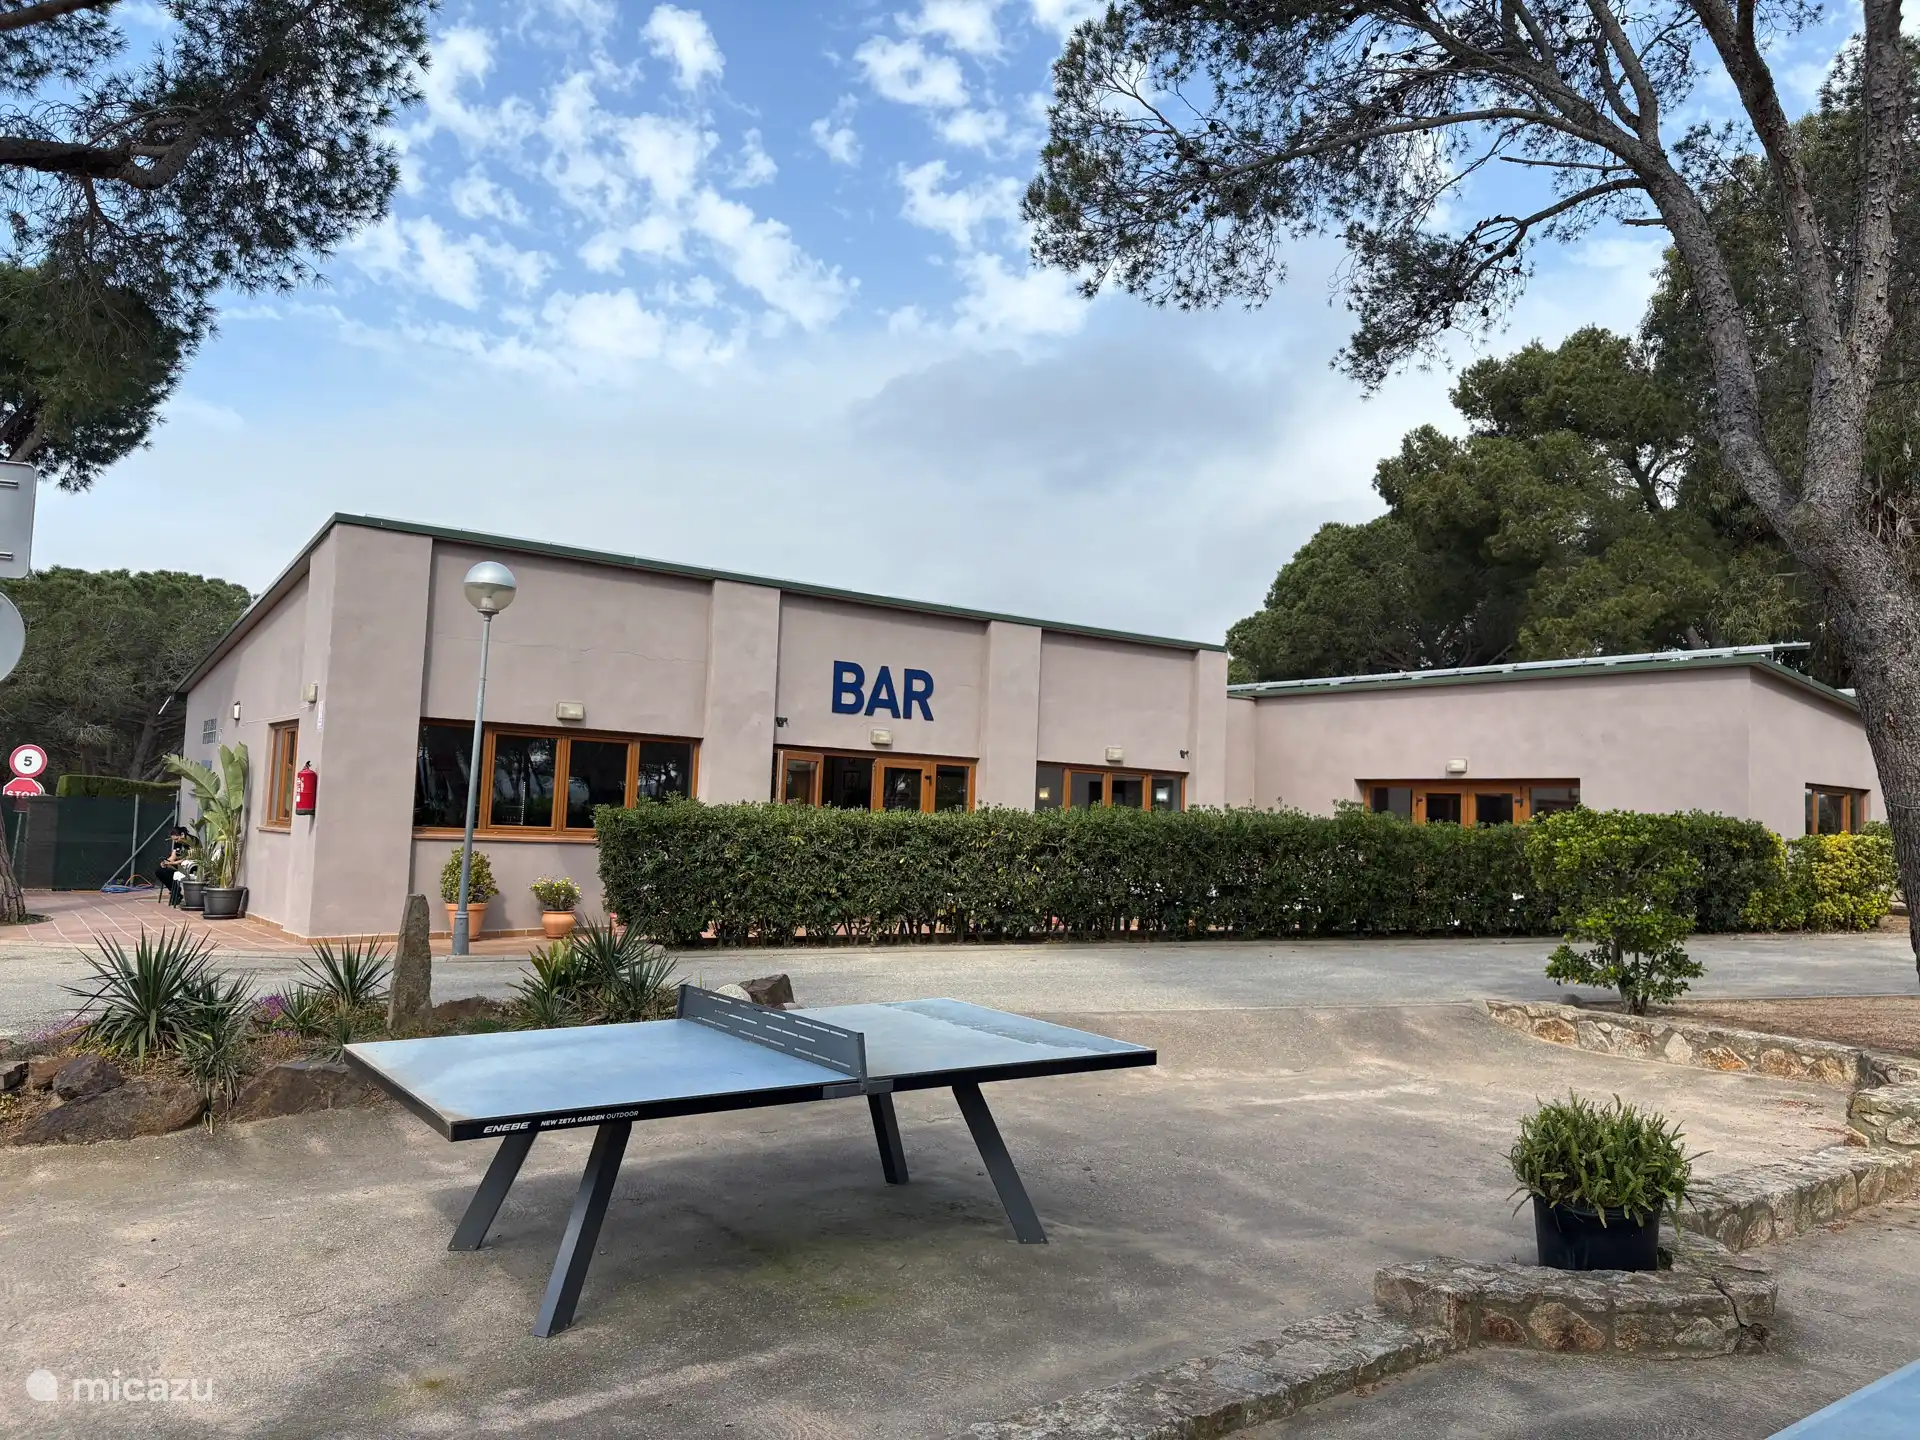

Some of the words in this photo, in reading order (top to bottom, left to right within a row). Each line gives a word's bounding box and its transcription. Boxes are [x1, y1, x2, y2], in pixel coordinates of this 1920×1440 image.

[832, 660, 934, 722] BAR
[23, 755, 33, 767] 5
[483, 1121, 531, 1134] ENEBE
[540, 1119, 558, 1127] NEW
[558, 1117, 576, 1125] ZETA
[577, 1114, 606, 1123] GARDEN
[606, 1110, 639, 1119] OUTDOOR
